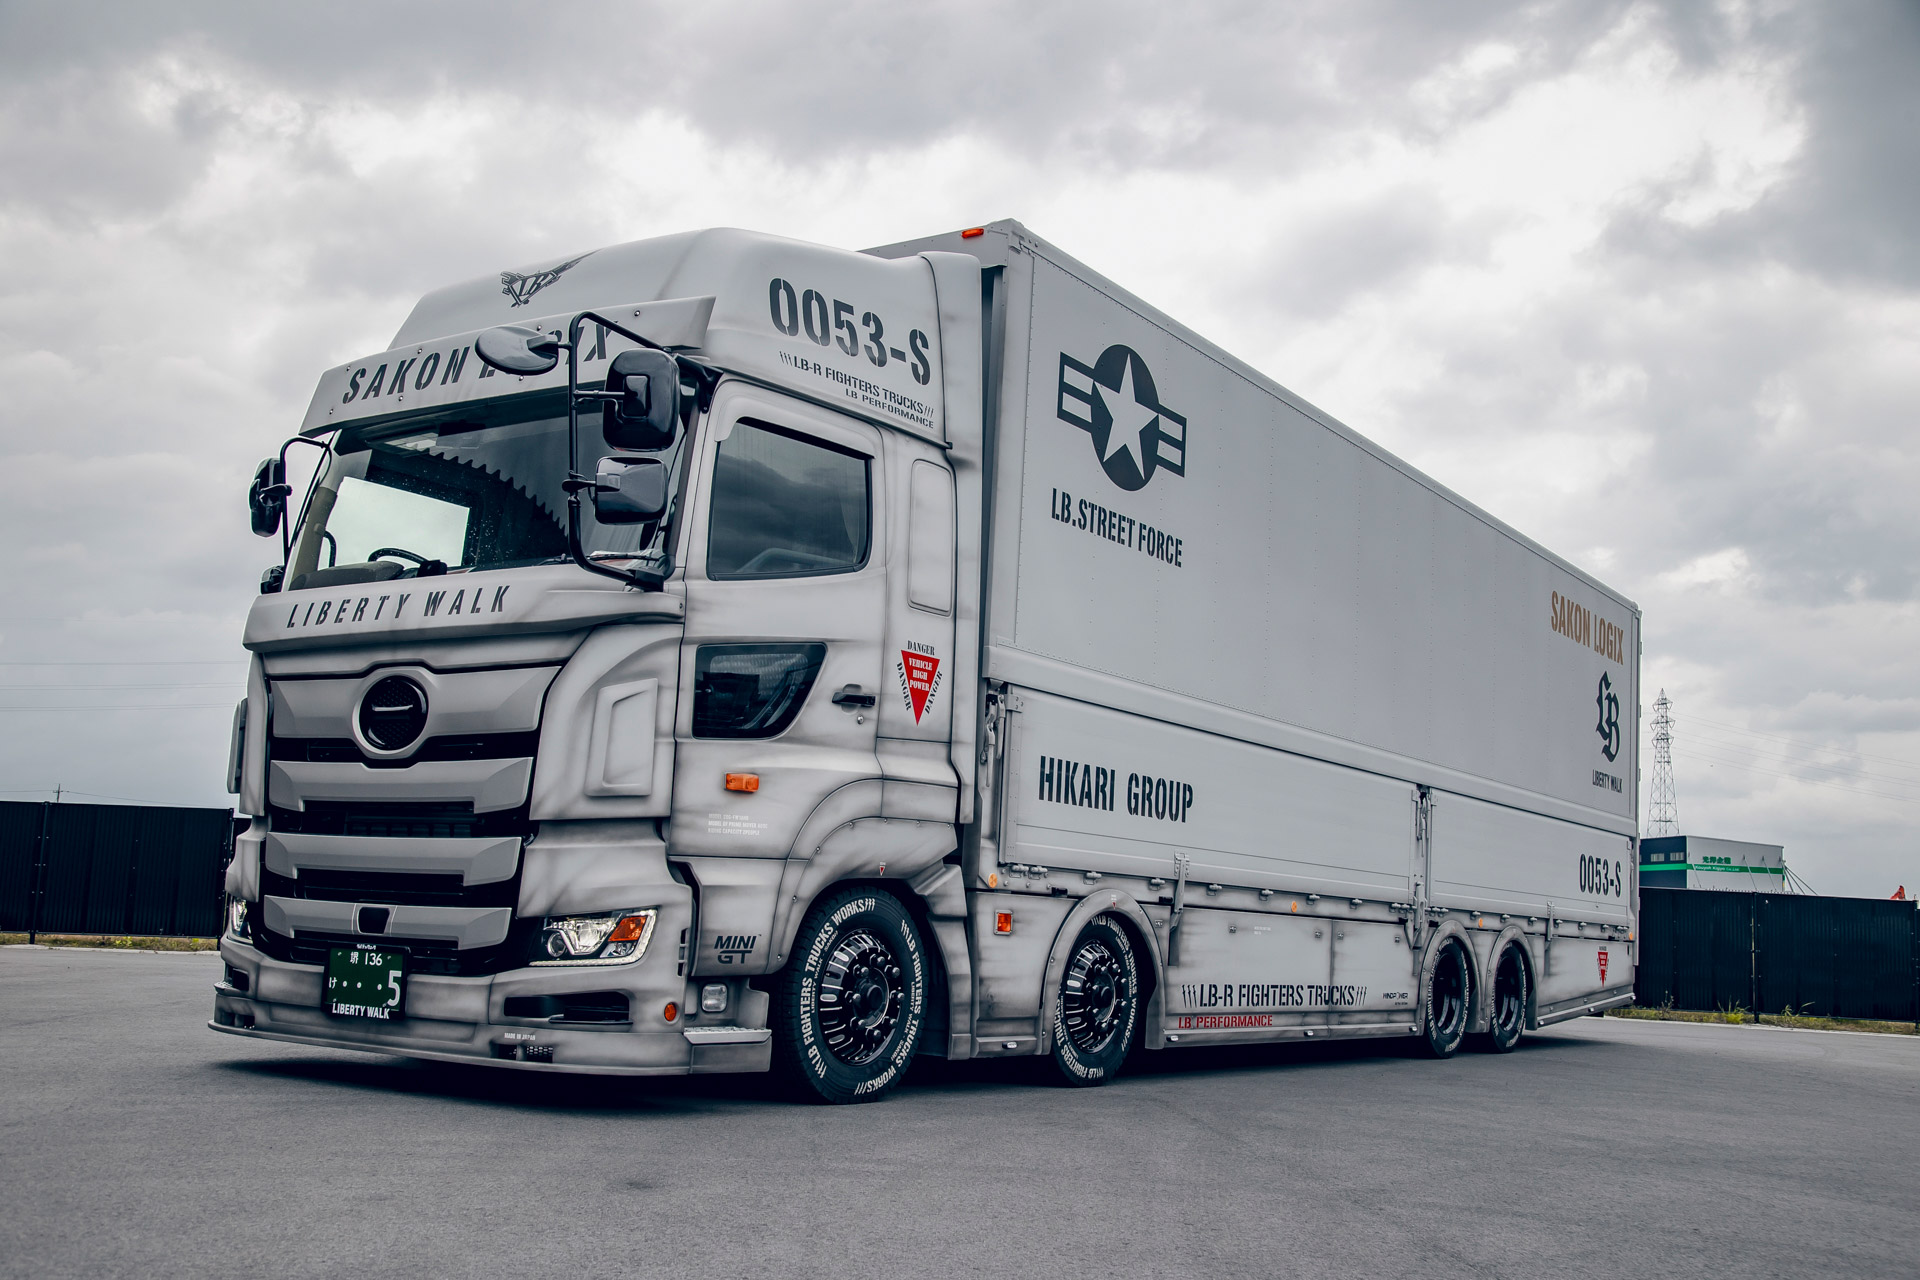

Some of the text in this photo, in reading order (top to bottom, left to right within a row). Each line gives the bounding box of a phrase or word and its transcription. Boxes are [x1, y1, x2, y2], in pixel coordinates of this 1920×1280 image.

[769, 278, 931, 386] 0053-S
[342, 346, 470, 404] SAKON
[825, 367, 880, 397] FIGHTERS
[845, 388, 934, 429] LB PERFORMANCE
[1138, 522, 1183, 568] FORCE
[286, 585, 510, 629] LIBERTY WALK
[907, 640, 935, 656] DANGER
[1551, 590, 1624, 666] SAKON LOGIX
[908, 657, 933, 671] VEHICLE
[912, 669, 928, 680] HIGH
[897, 662, 911, 711] DANGER
[909, 679, 929, 692] POWER
[924, 671, 942, 714] DANGER
[1038, 755, 1194, 823] HIKARI GROUP
[1592, 769, 1610, 789] LIBERTY
[1579, 853, 1622, 898] 0053-S
[364, 952, 383, 966] 136
[713, 935, 757, 949] MINI
[717, 949, 753, 964] GT
[805, 922, 834, 972] TRUCKS
[1107, 917, 1130, 951] FIGHTERS
[1128, 949, 1137, 994] TRUCKS
[328, 976, 337, 989] け
[912, 951, 923, 1014] FIGHTERS
[1238, 983, 1304, 1008] FIGHTERS
[331, 1002, 390, 1019] LIBERTY WALK
[800, 977, 815, 1046] FIGHTERS
[1178, 1015, 1273, 1029] LB PERFORMANCE
[895, 1019, 919, 1067] TRUCKS
[1061, 1044, 1088, 1078] FIGHTERS
